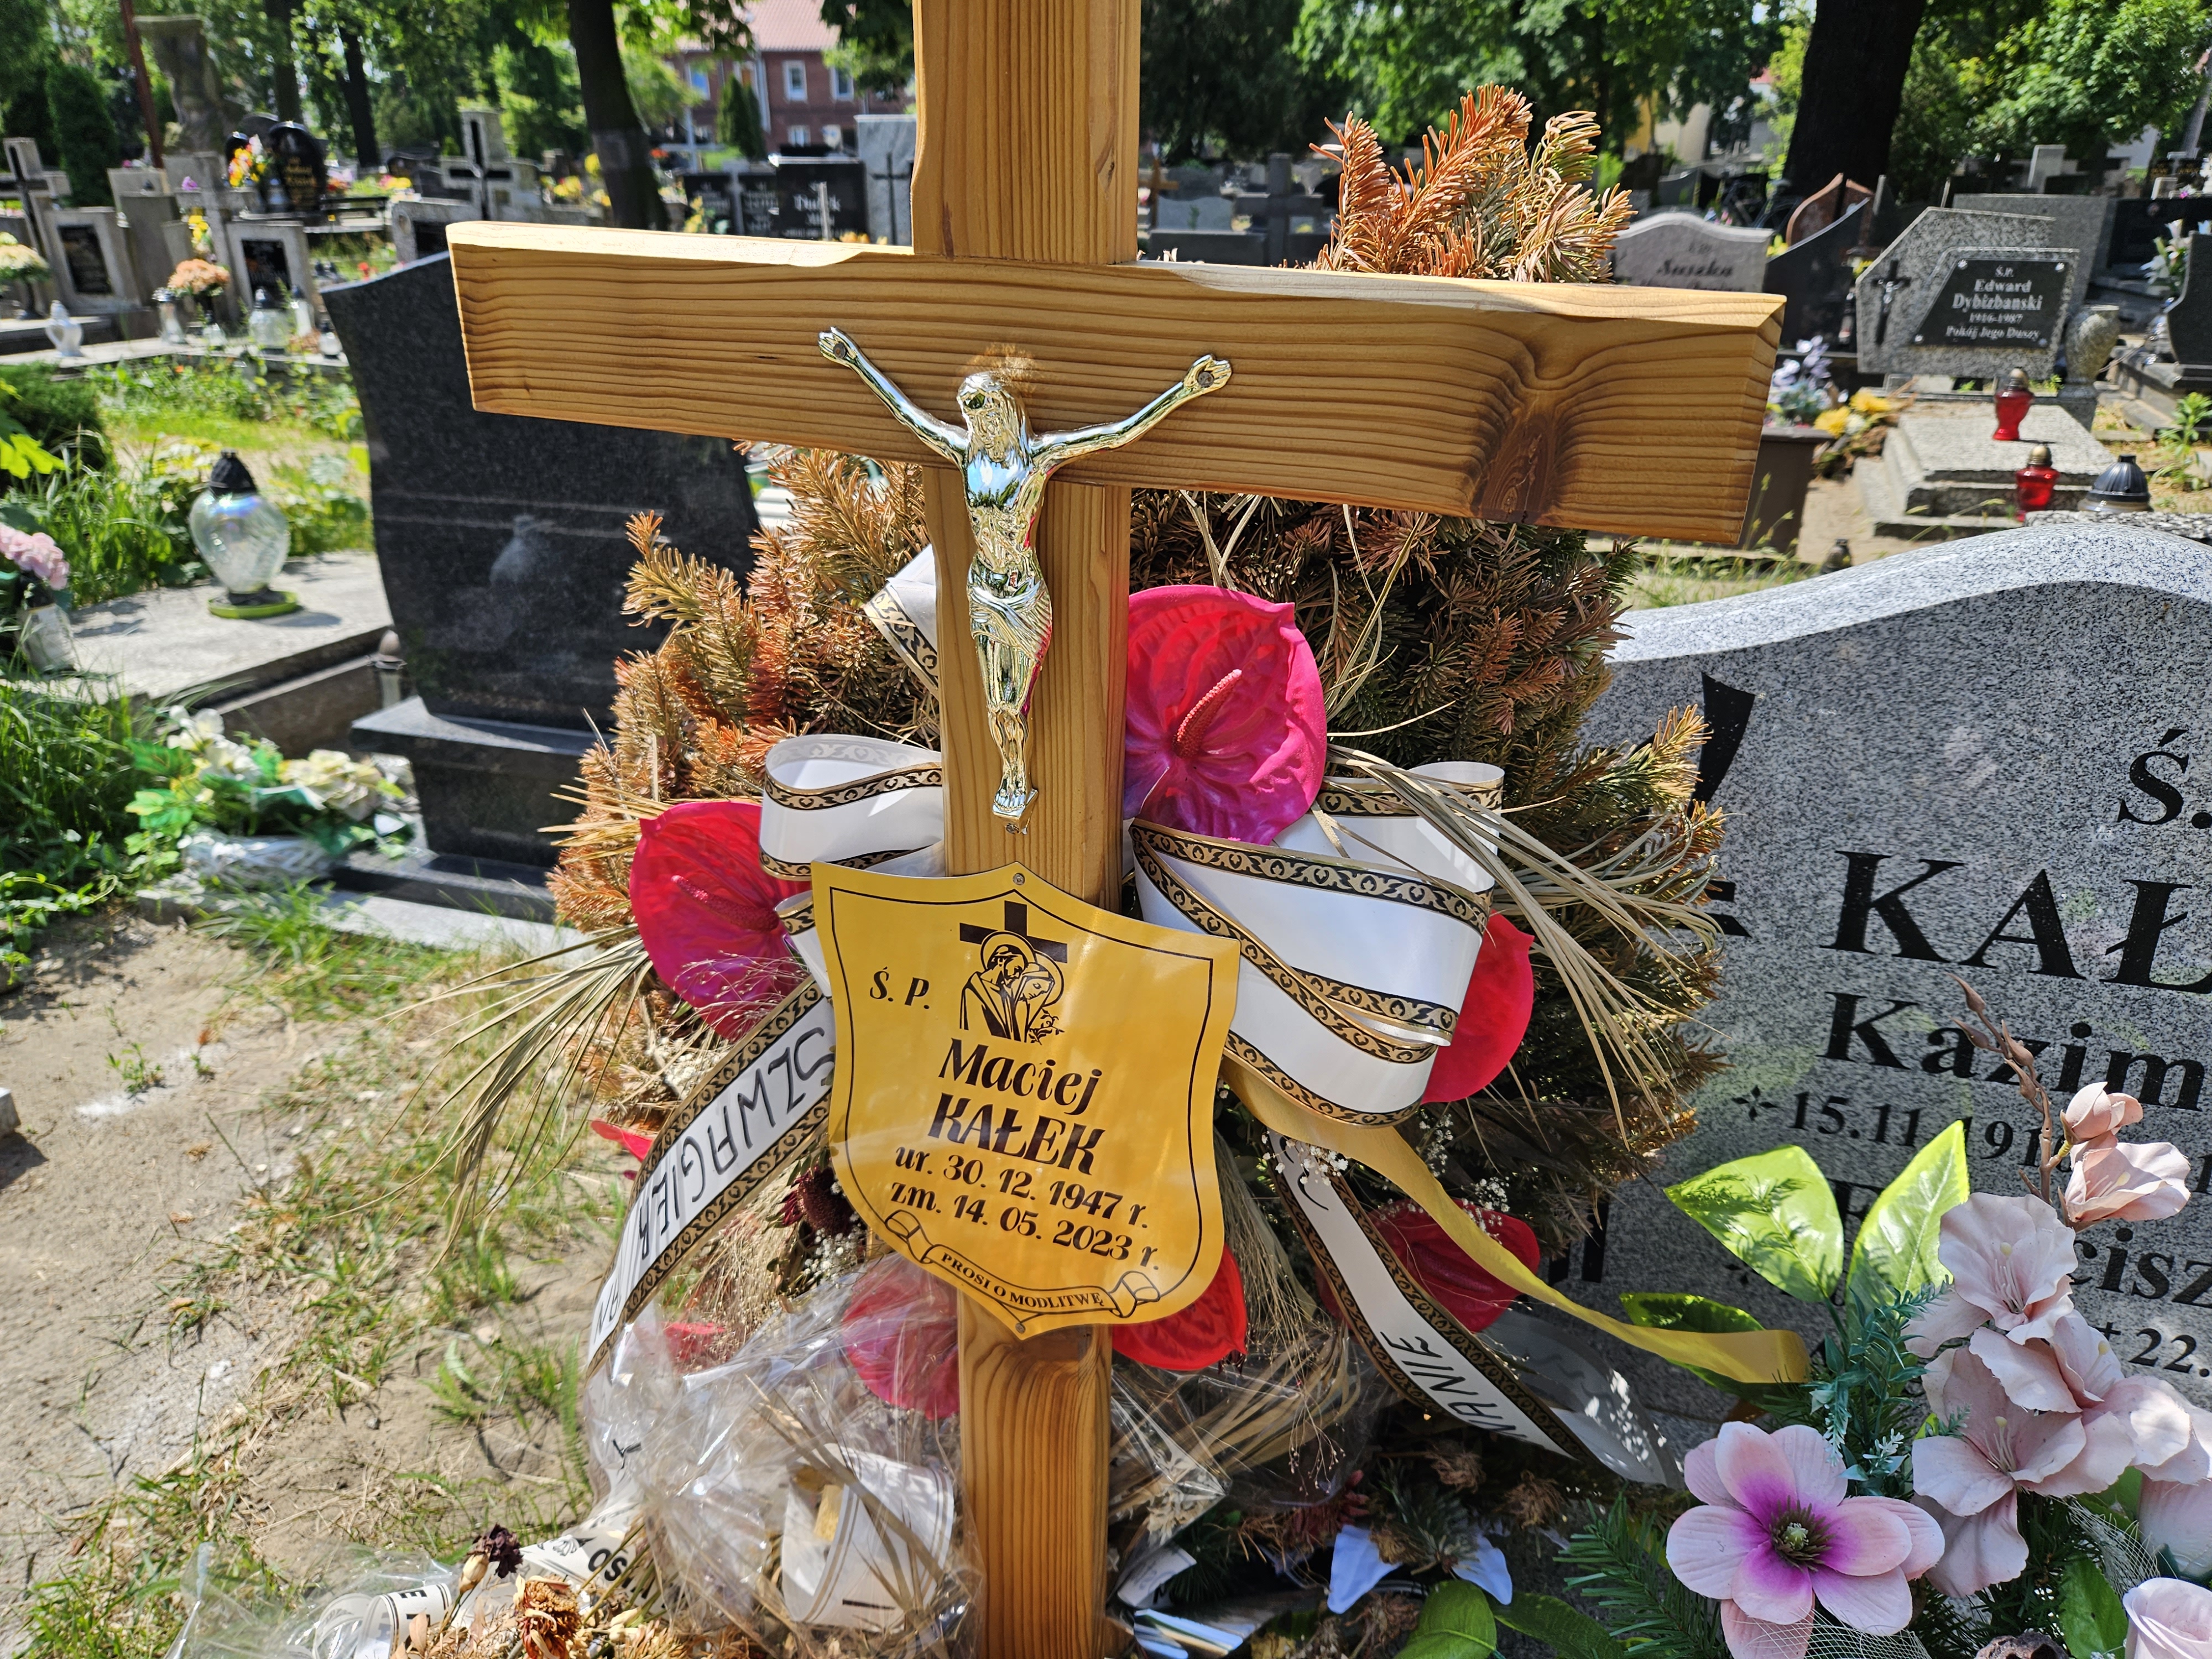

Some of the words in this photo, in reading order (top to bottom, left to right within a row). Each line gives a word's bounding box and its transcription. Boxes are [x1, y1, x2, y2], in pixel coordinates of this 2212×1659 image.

[1968, 311, 2024, 325] 1916-1987
[1974, 278, 2032, 294] Edward
[1945, 325, 1979, 341] Pokój
[1979, 326, 2005, 341] Jego
[2006, 326, 2041, 342] Duszy
[1819, 850, 2212, 995] KAŁ
[869, 966, 894, 1002] Ś.
[905, 977, 931, 1010] P.
[938, 1037, 1102, 1115] Maciej
[1815, 992, 2204, 1113] Kazim
[638, 1026, 835, 1259] SZWAGIER
[927, 1092, 1105, 1178] KAŁEK
[890, 1182, 941, 1214] zm.
[954, 1195, 988, 1225] 14.
[1000, 1207, 1042, 1239] 05.
[1052, 1220, 1133, 1260] 2023
[1140, 1246, 1160, 1270] r.
[895, 1147, 933, 1175] ur.
[943, 1155, 986, 1188] 30.
[999, 1168, 1036, 1201] 12.
[1049, 1181, 1123, 1219] 1947
[1128, 1204, 1149, 1228] r.
[941, 1253, 990, 1289] PROSI
[994, 1286, 1006, 1297] O
[1010, 1292, 1105, 1308] MODLITWĘ
